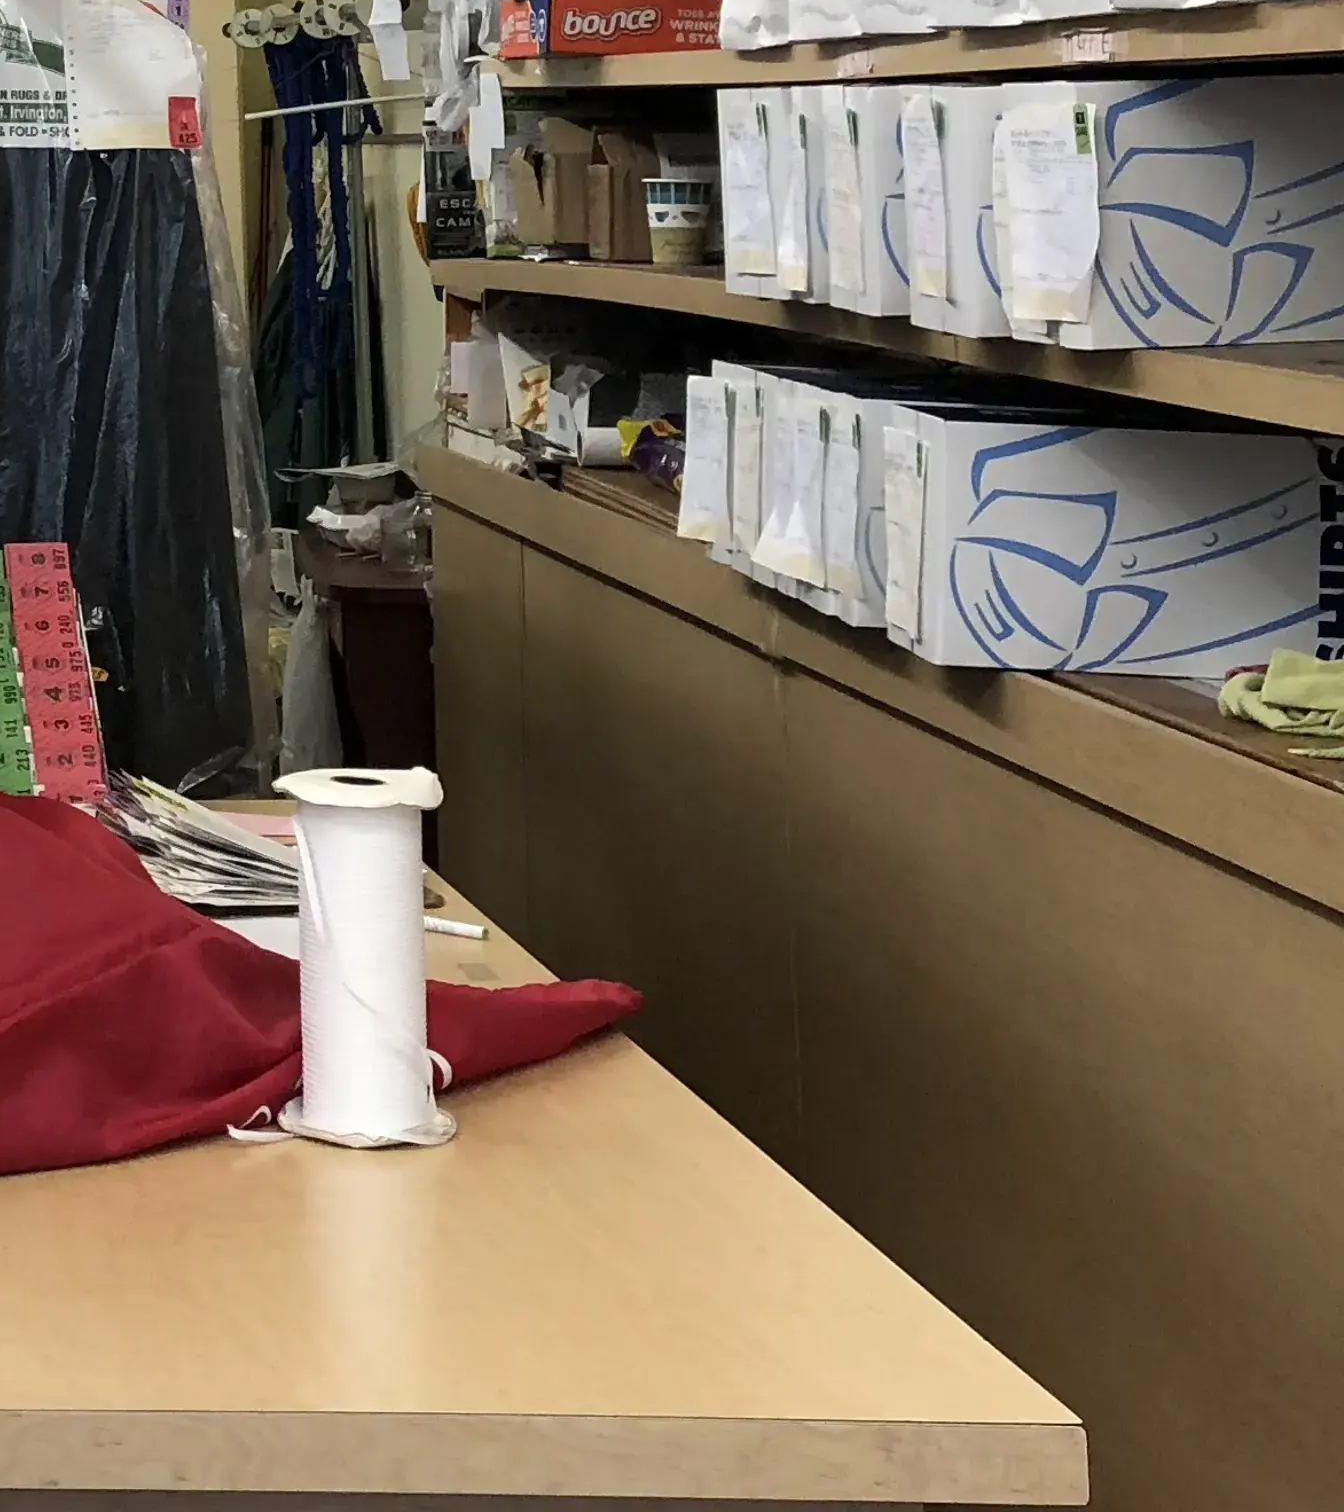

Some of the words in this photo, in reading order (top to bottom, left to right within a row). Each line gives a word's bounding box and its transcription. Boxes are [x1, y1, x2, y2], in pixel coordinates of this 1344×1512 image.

[564, 8, 658, 36] bounce
[677, 9, 705, 18] TOSS
[675, 33, 685, 43] &
[11, 89, 39, 101] RUGS
[11, 105, 69, 122] Irvington,
[9, 125, 39, 137] FOLD
[59, 615, 73, 635] 240
[4, 685, 18, 705] 990
[16, 748, 30, 771] 213
